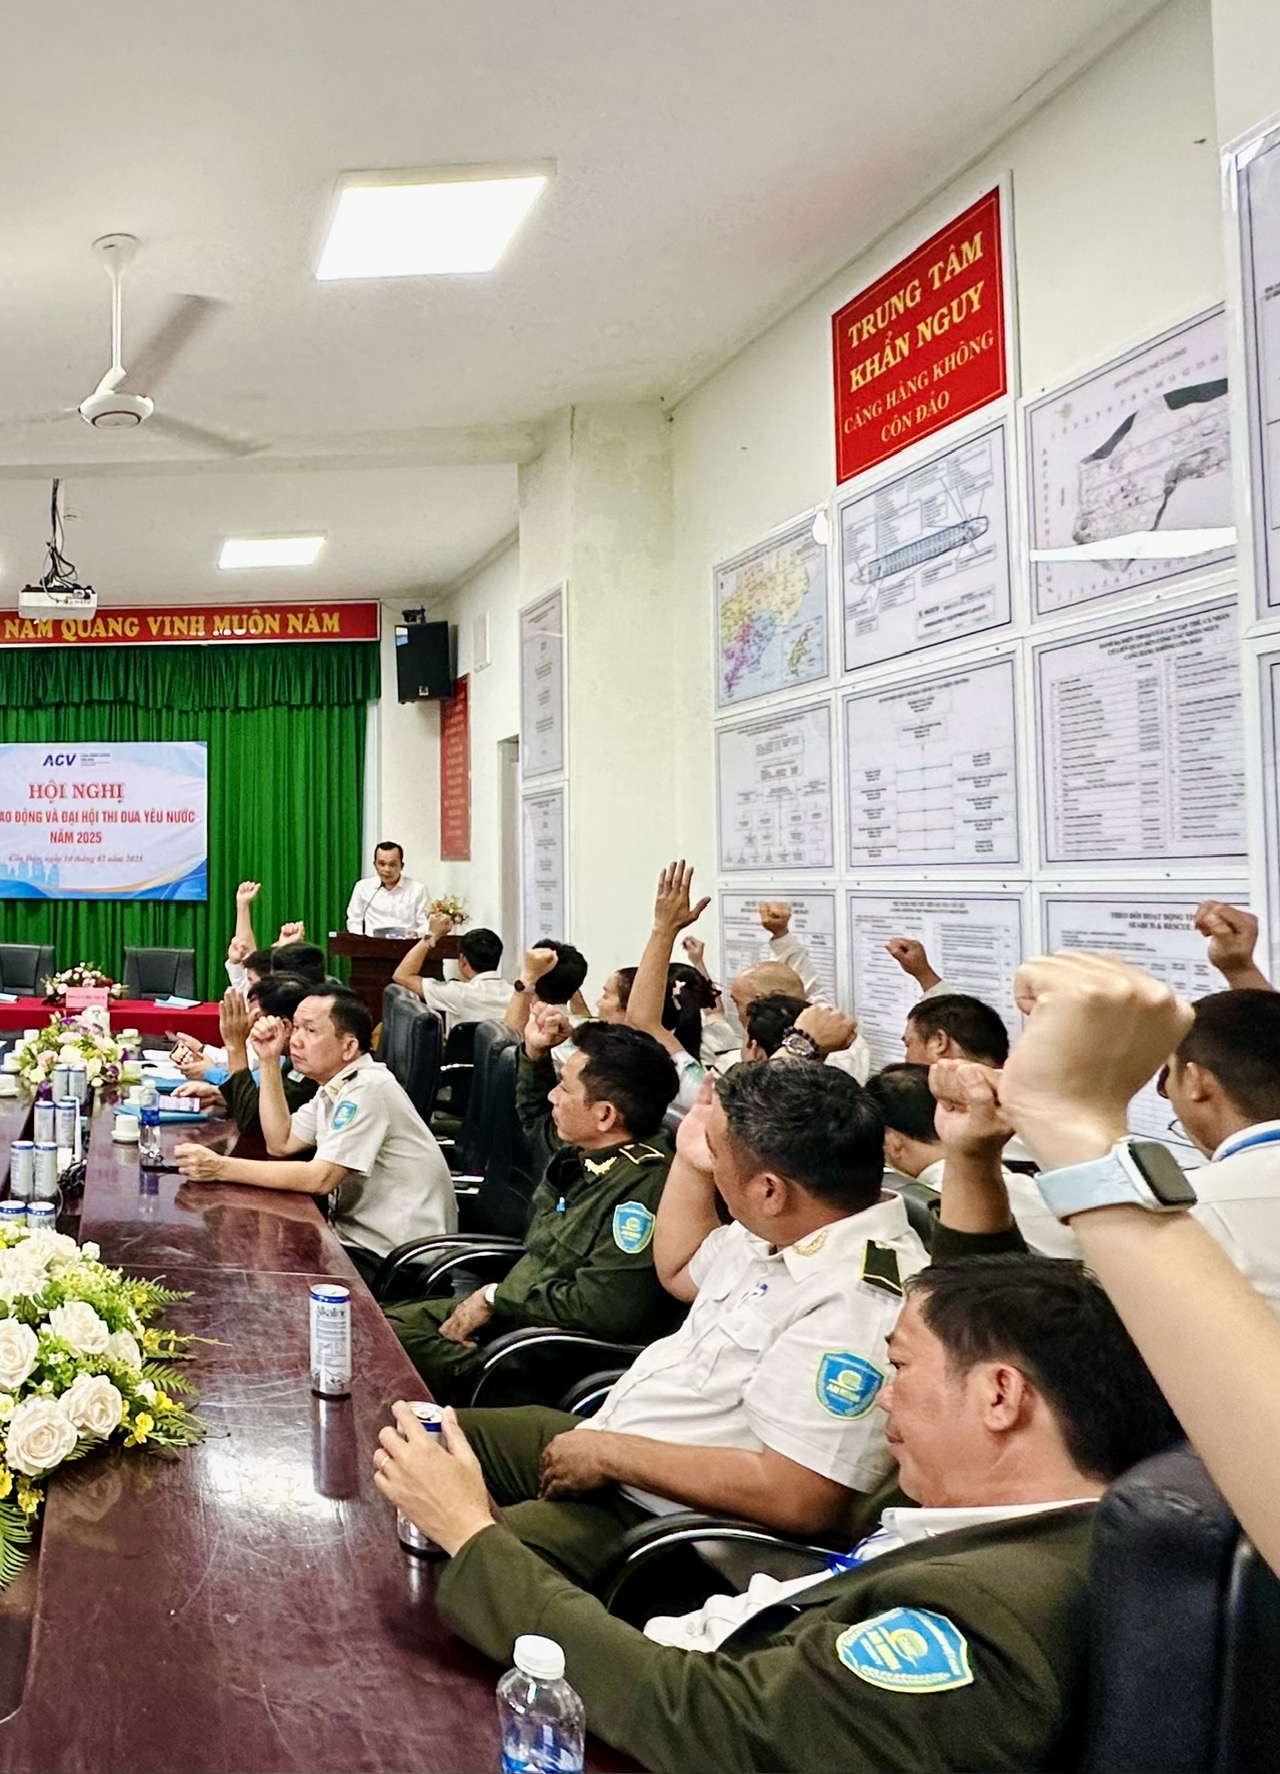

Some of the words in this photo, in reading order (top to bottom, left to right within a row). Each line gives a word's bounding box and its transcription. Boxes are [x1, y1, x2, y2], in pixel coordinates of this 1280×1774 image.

[848, 279, 922, 348] TRUNG
[928, 231, 984, 290] TÂM
[850, 331, 911, 393] KHẨN
[916, 281, 985, 348] NGUY
[844, 406, 883, 434] CẢNG
[886, 370, 929, 410] HÀNG
[932, 329, 995, 382] KHÔNG
[881, 414, 913, 442] CÔN
[915, 390, 950, 424] ĐẢO
[4, 617, 54, 639] NAM
[61, 616, 140, 642] QUANG
[147, 615, 205, 637] VINH
[212, 608, 281, 636] MUÔN
[286, 607, 341, 634] NĂM
[43, 753, 77, 767] ACV
[28, 778, 66, 804] HỘI
[72, 782, 125, 804] NGHỊ
[14, 808, 42, 826] ĐỘNG
[45, 808, 59, 823] VÀ
[61, 810, 79, 826] ĐẠI
[81, 808, 99, 826] HỘI
[102, 810, 118, 823] THI
[120, 810, 141, 823] ĐUA
[143, 807, 164, 823] YÊU
[166, 808, 196, 823] NƯỚC
[49, 829, 74, 844] NĂM
[76, 831, 102, 844] 2025
